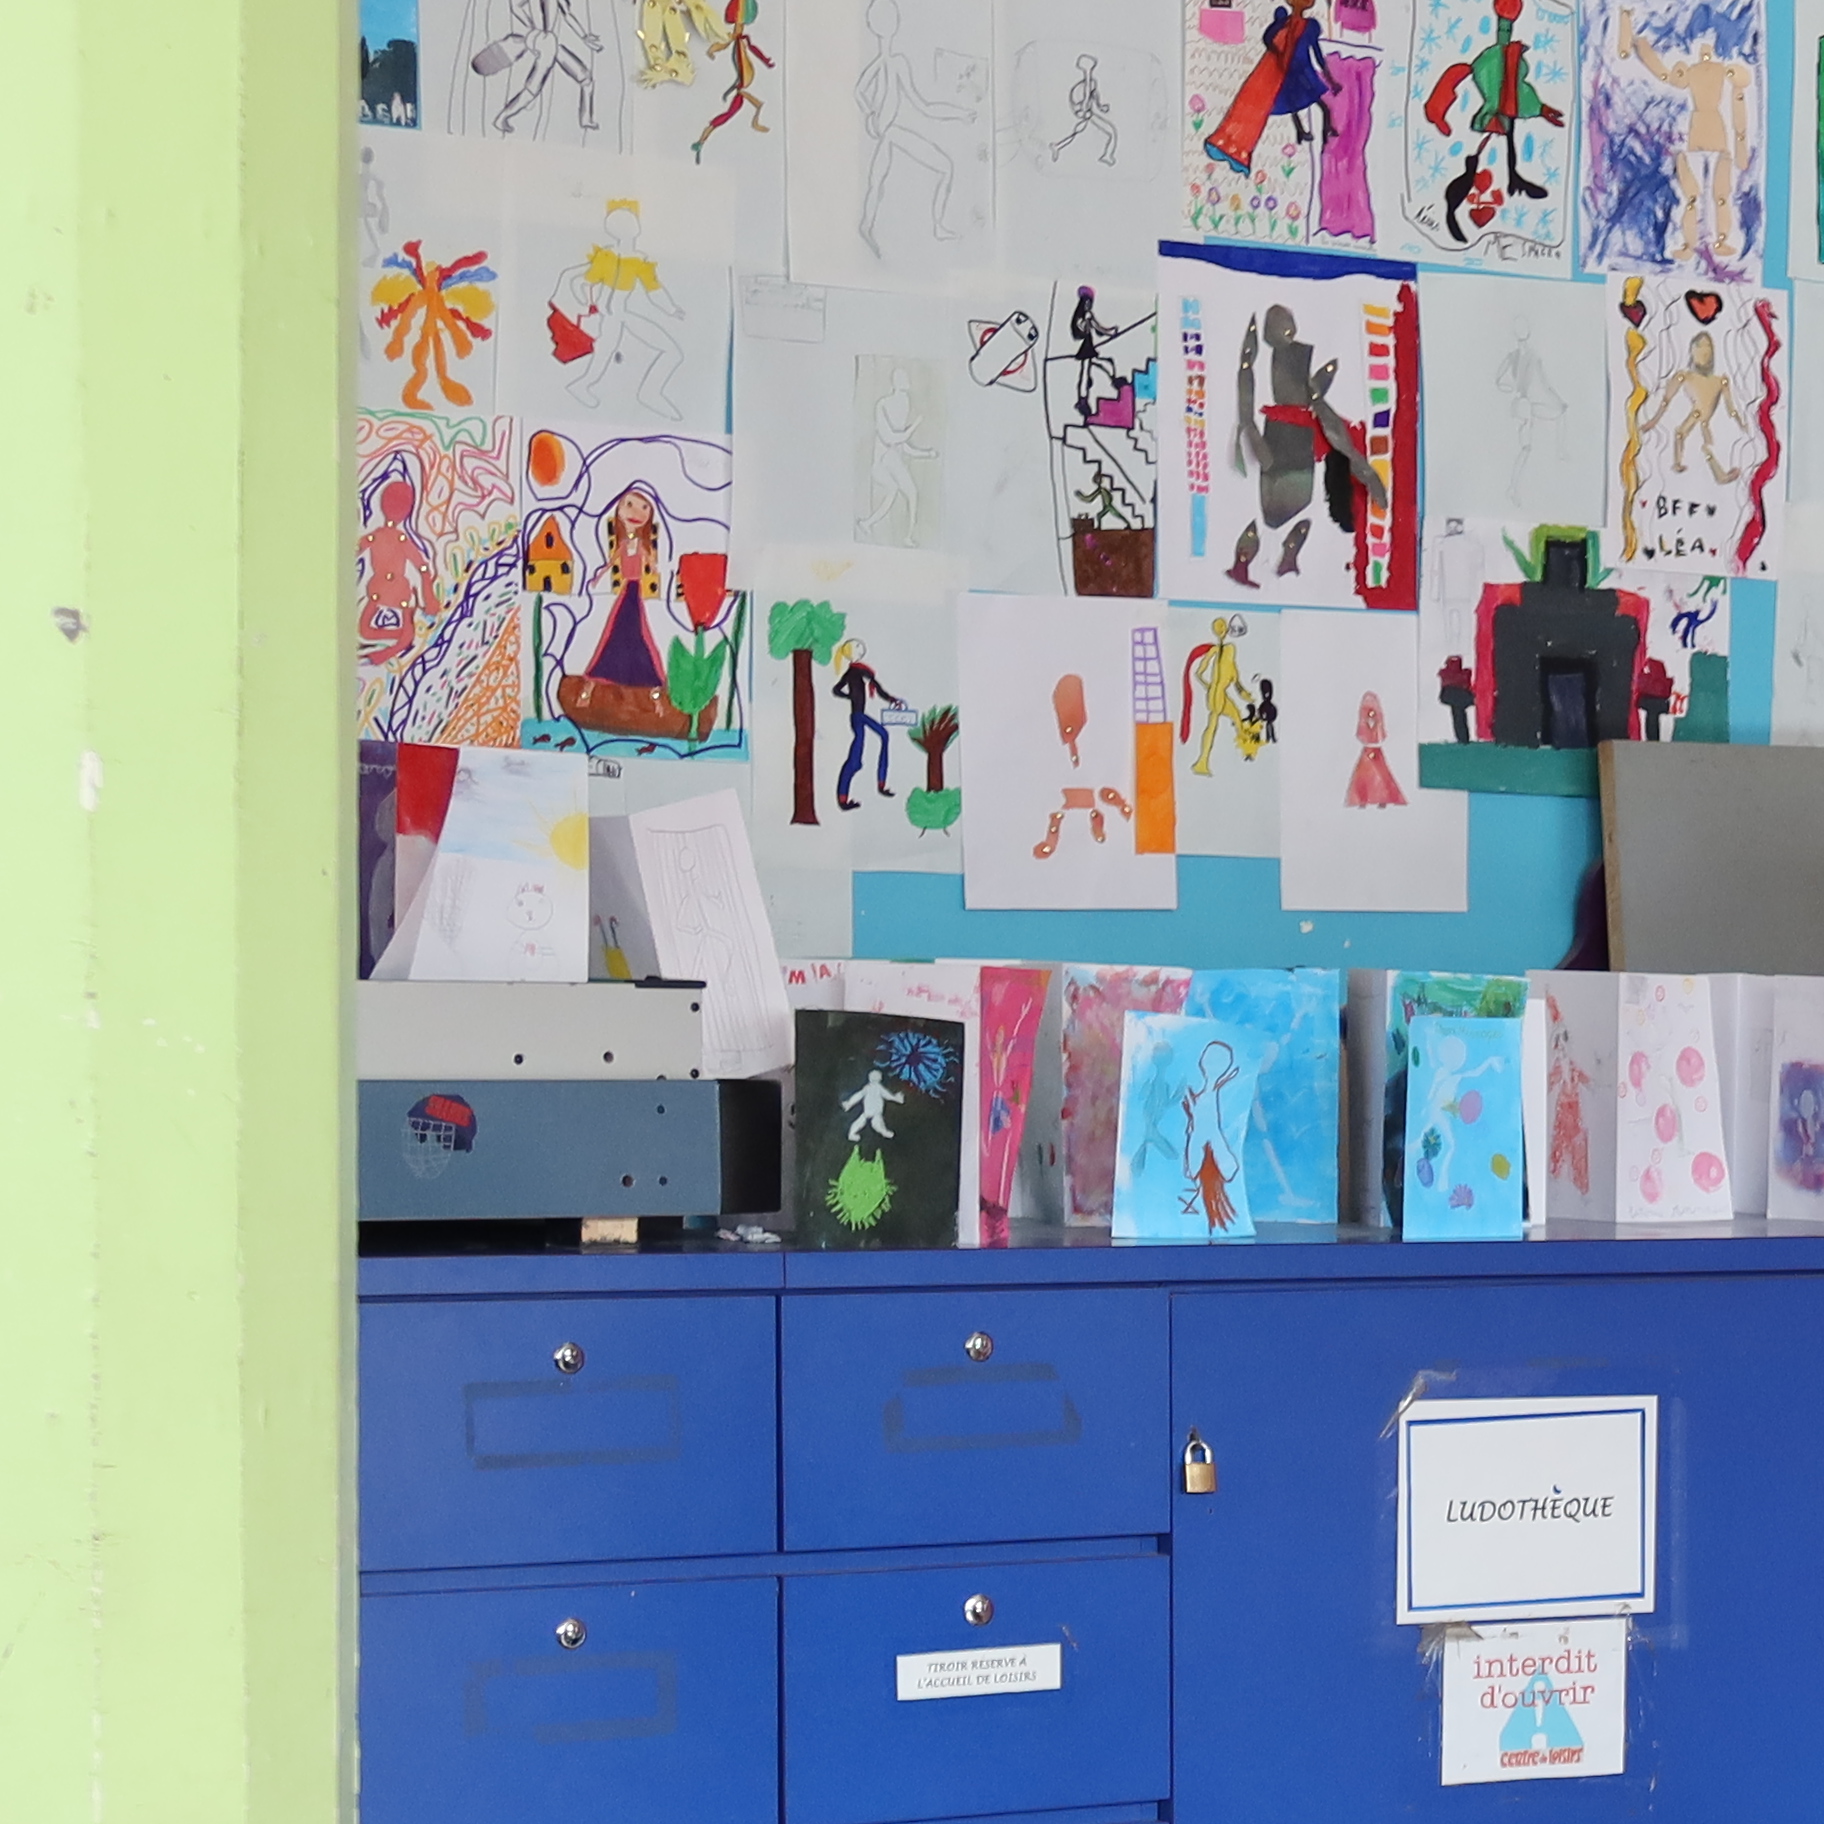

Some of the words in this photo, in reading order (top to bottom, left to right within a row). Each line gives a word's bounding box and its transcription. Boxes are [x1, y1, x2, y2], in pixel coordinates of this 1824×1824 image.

[1656, 495, 1700, 518] BFF
[1659, 528, 1704, 557] LÉA
[1446, 1483, 1615, 1523] LUDOTHÈQUE
[927, 1660, 967, 1674] TIROIR
[1474, 1648, 1598, 1680] interdit
[917, 1676, 973, 1690] L'ACCUEIL
[976, 1674, 991, 1686] DE
[994, 1671, 1037, 1684] LOISIRS
[1480, 1682, 1595, 1710] d'ouvrir
